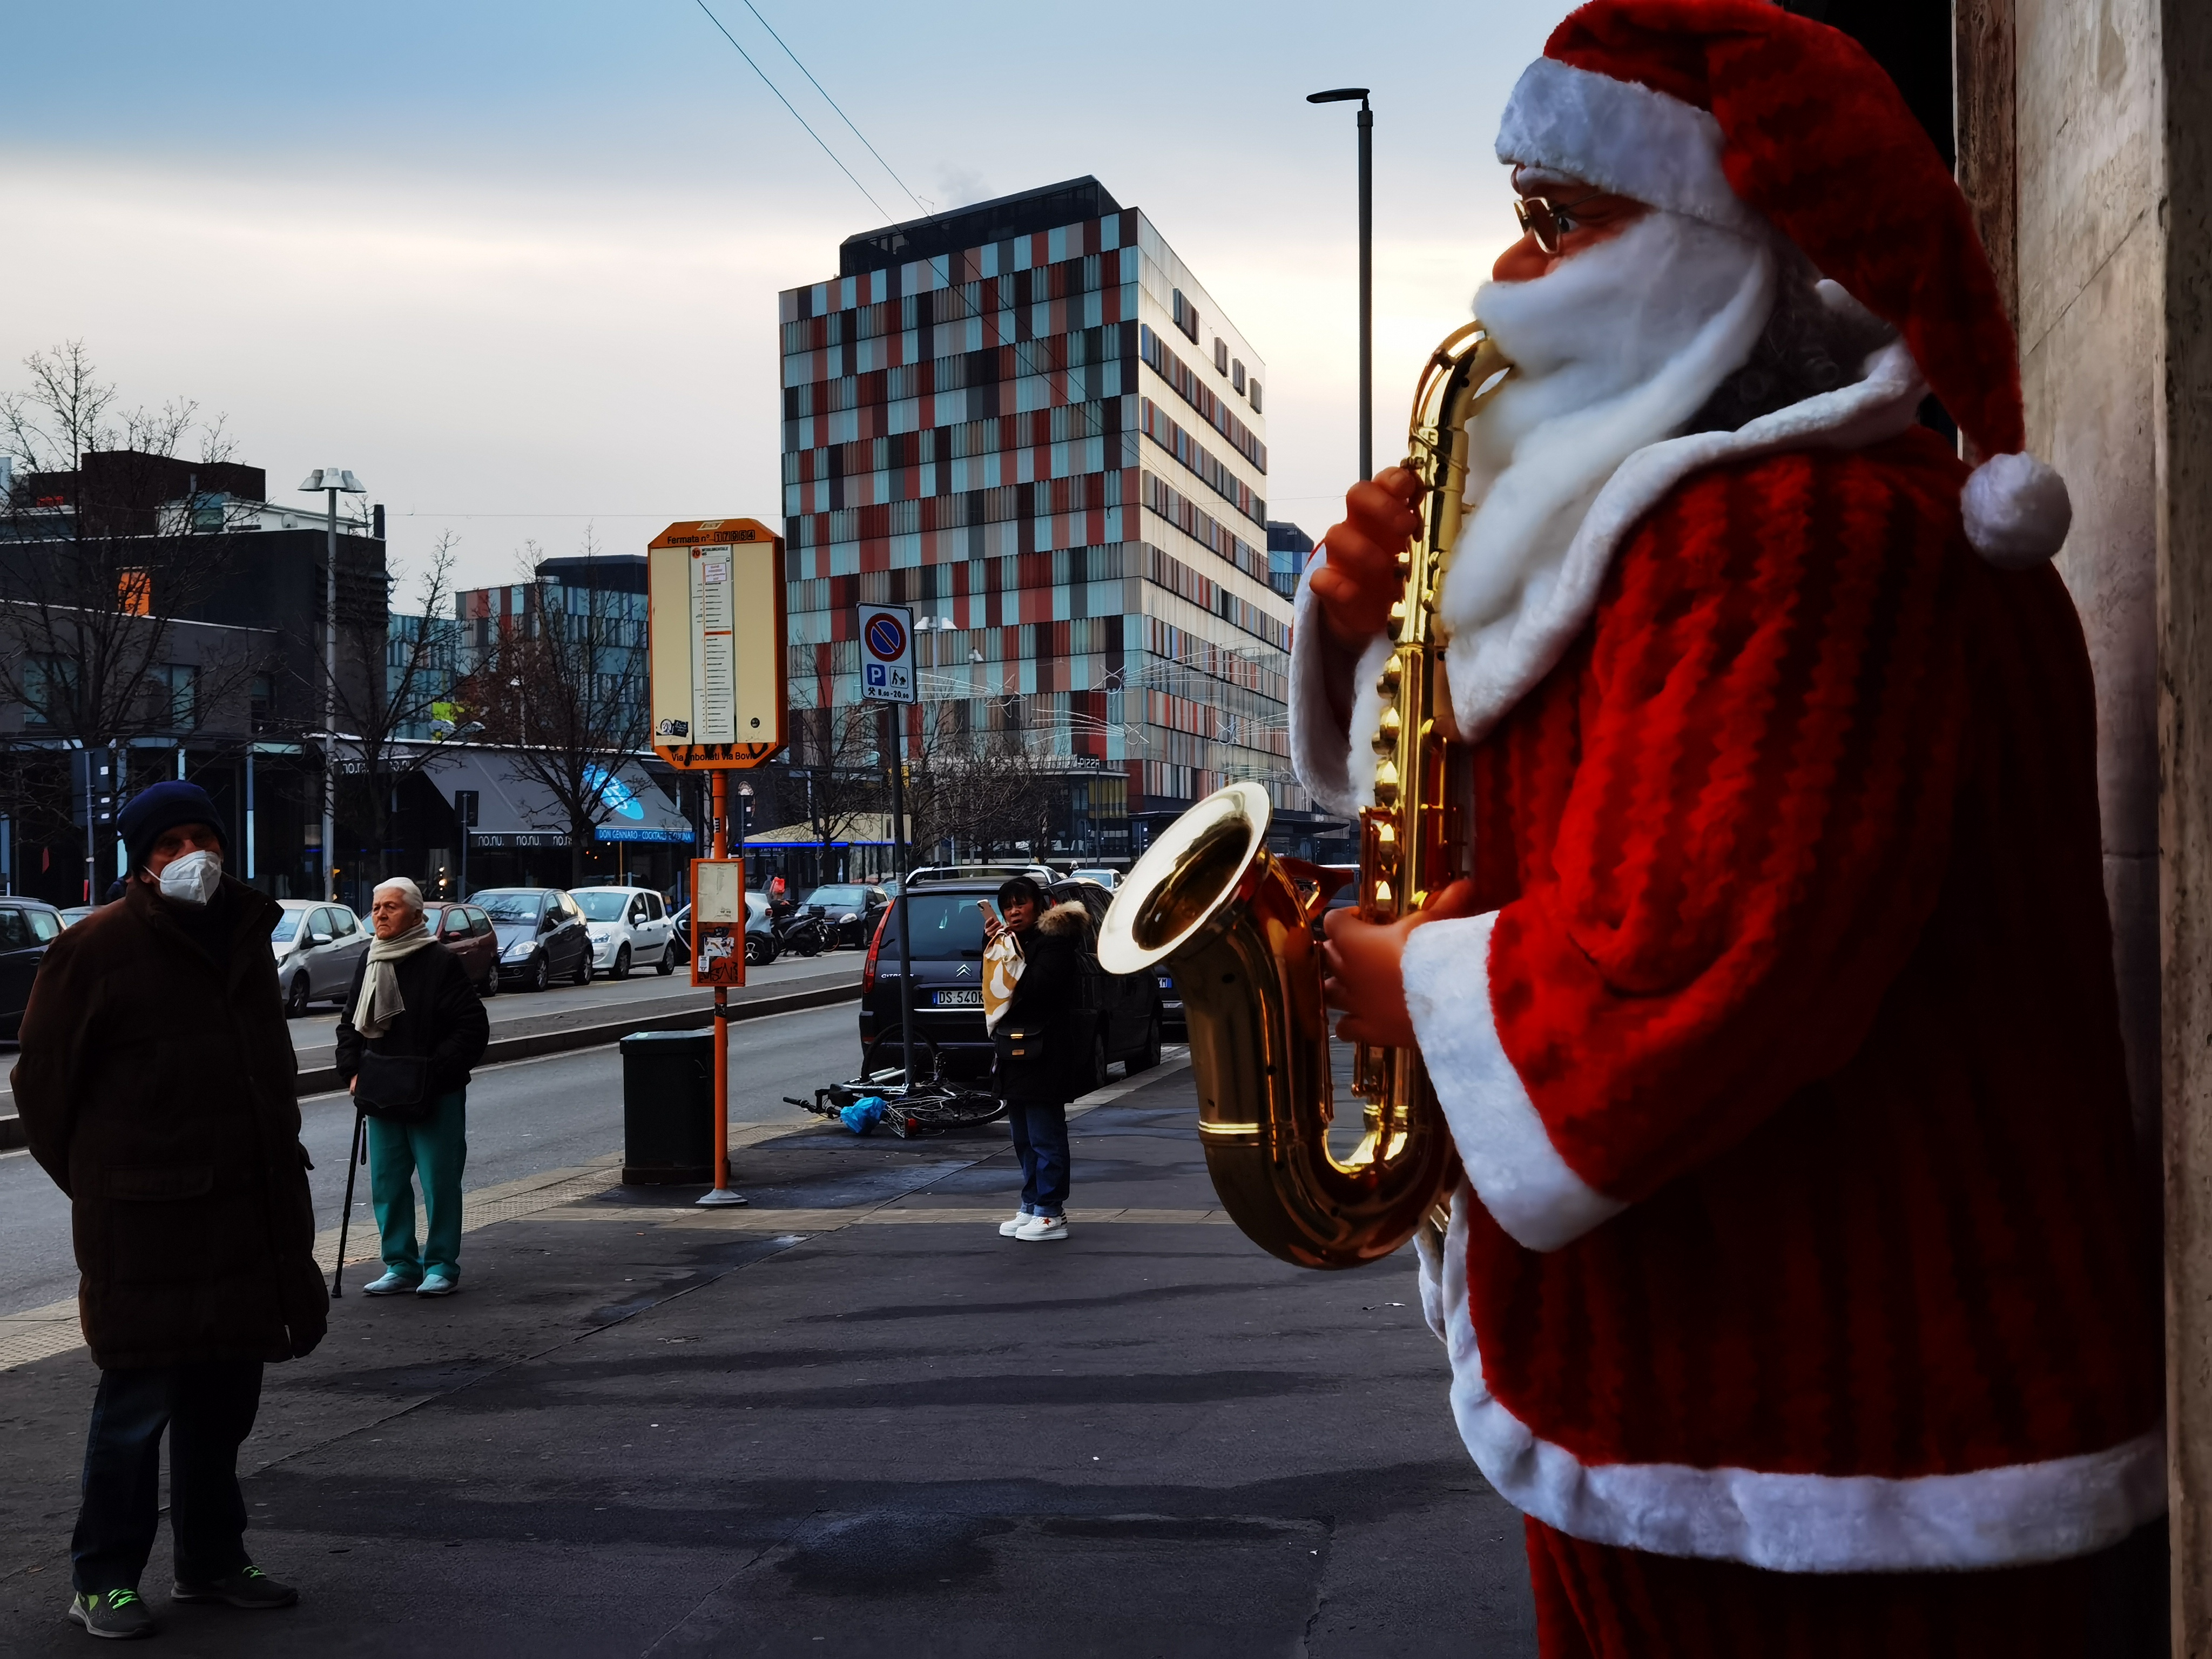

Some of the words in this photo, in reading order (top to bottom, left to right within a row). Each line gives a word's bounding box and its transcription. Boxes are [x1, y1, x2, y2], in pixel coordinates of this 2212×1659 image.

[667, 535, 699, 544] Fermata
[871, 667, 882, 683] P
[671, 753, 684, 761] Via
[599, 830, 611, 839] DON
[612, 831, 638, 839] GENNARO
[939, 991, 953, 1003] DS
